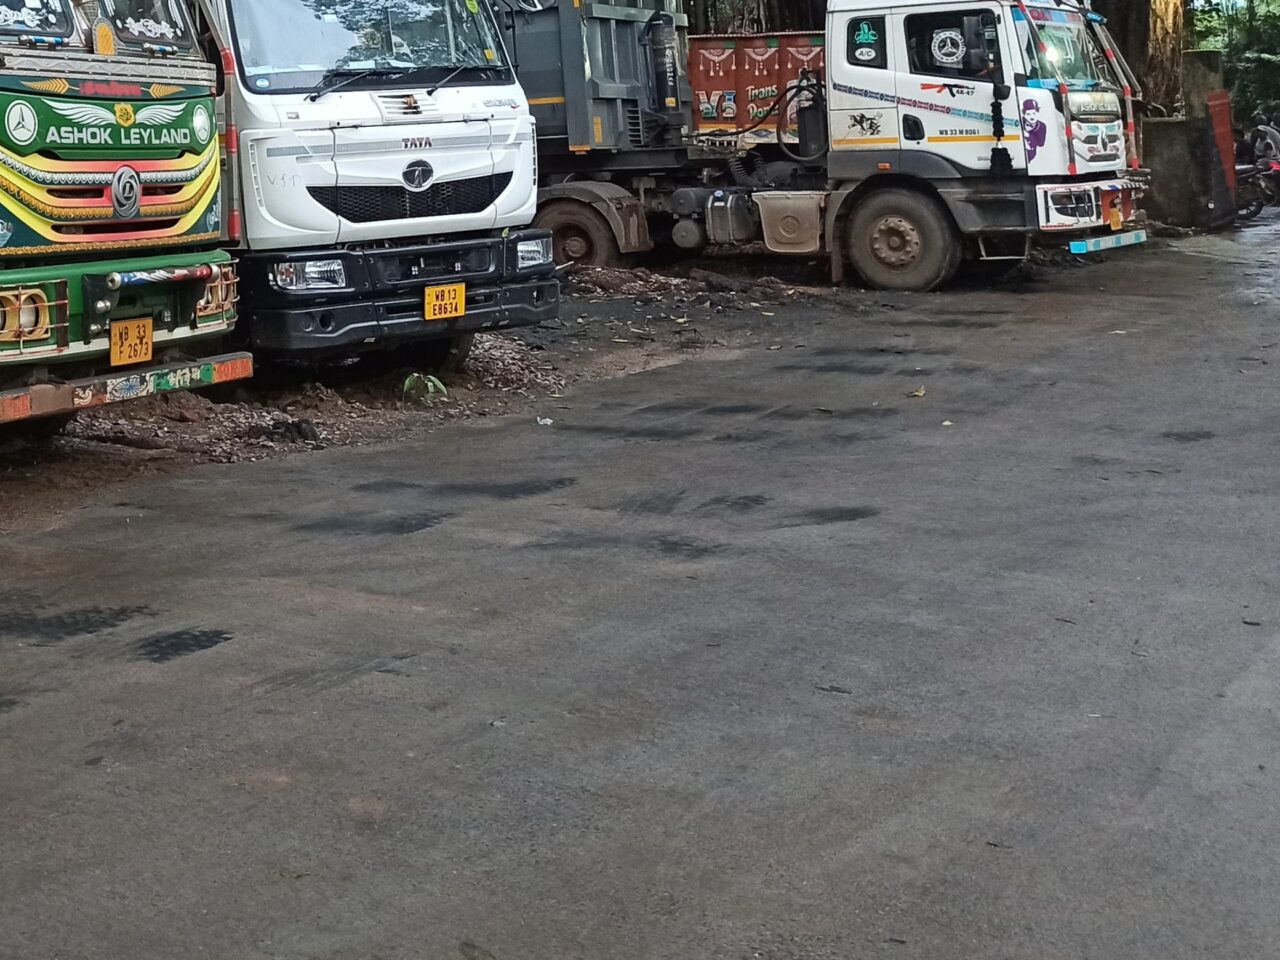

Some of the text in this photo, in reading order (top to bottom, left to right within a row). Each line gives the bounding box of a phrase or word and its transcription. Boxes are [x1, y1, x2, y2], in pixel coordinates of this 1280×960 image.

[858, 49, 872, 58] A/C
[745, 84, 778, 101] Trans
[45, 126, 191, 145] ASHOK LEYLAND
[402, 136, 433, 149] TATA
[434, 288, 457, 302] WB 13
[432, 301, 459, 316] E8634
[118, 324, 147, 342] WB 33
[128, 341, 149, 359] 2673
